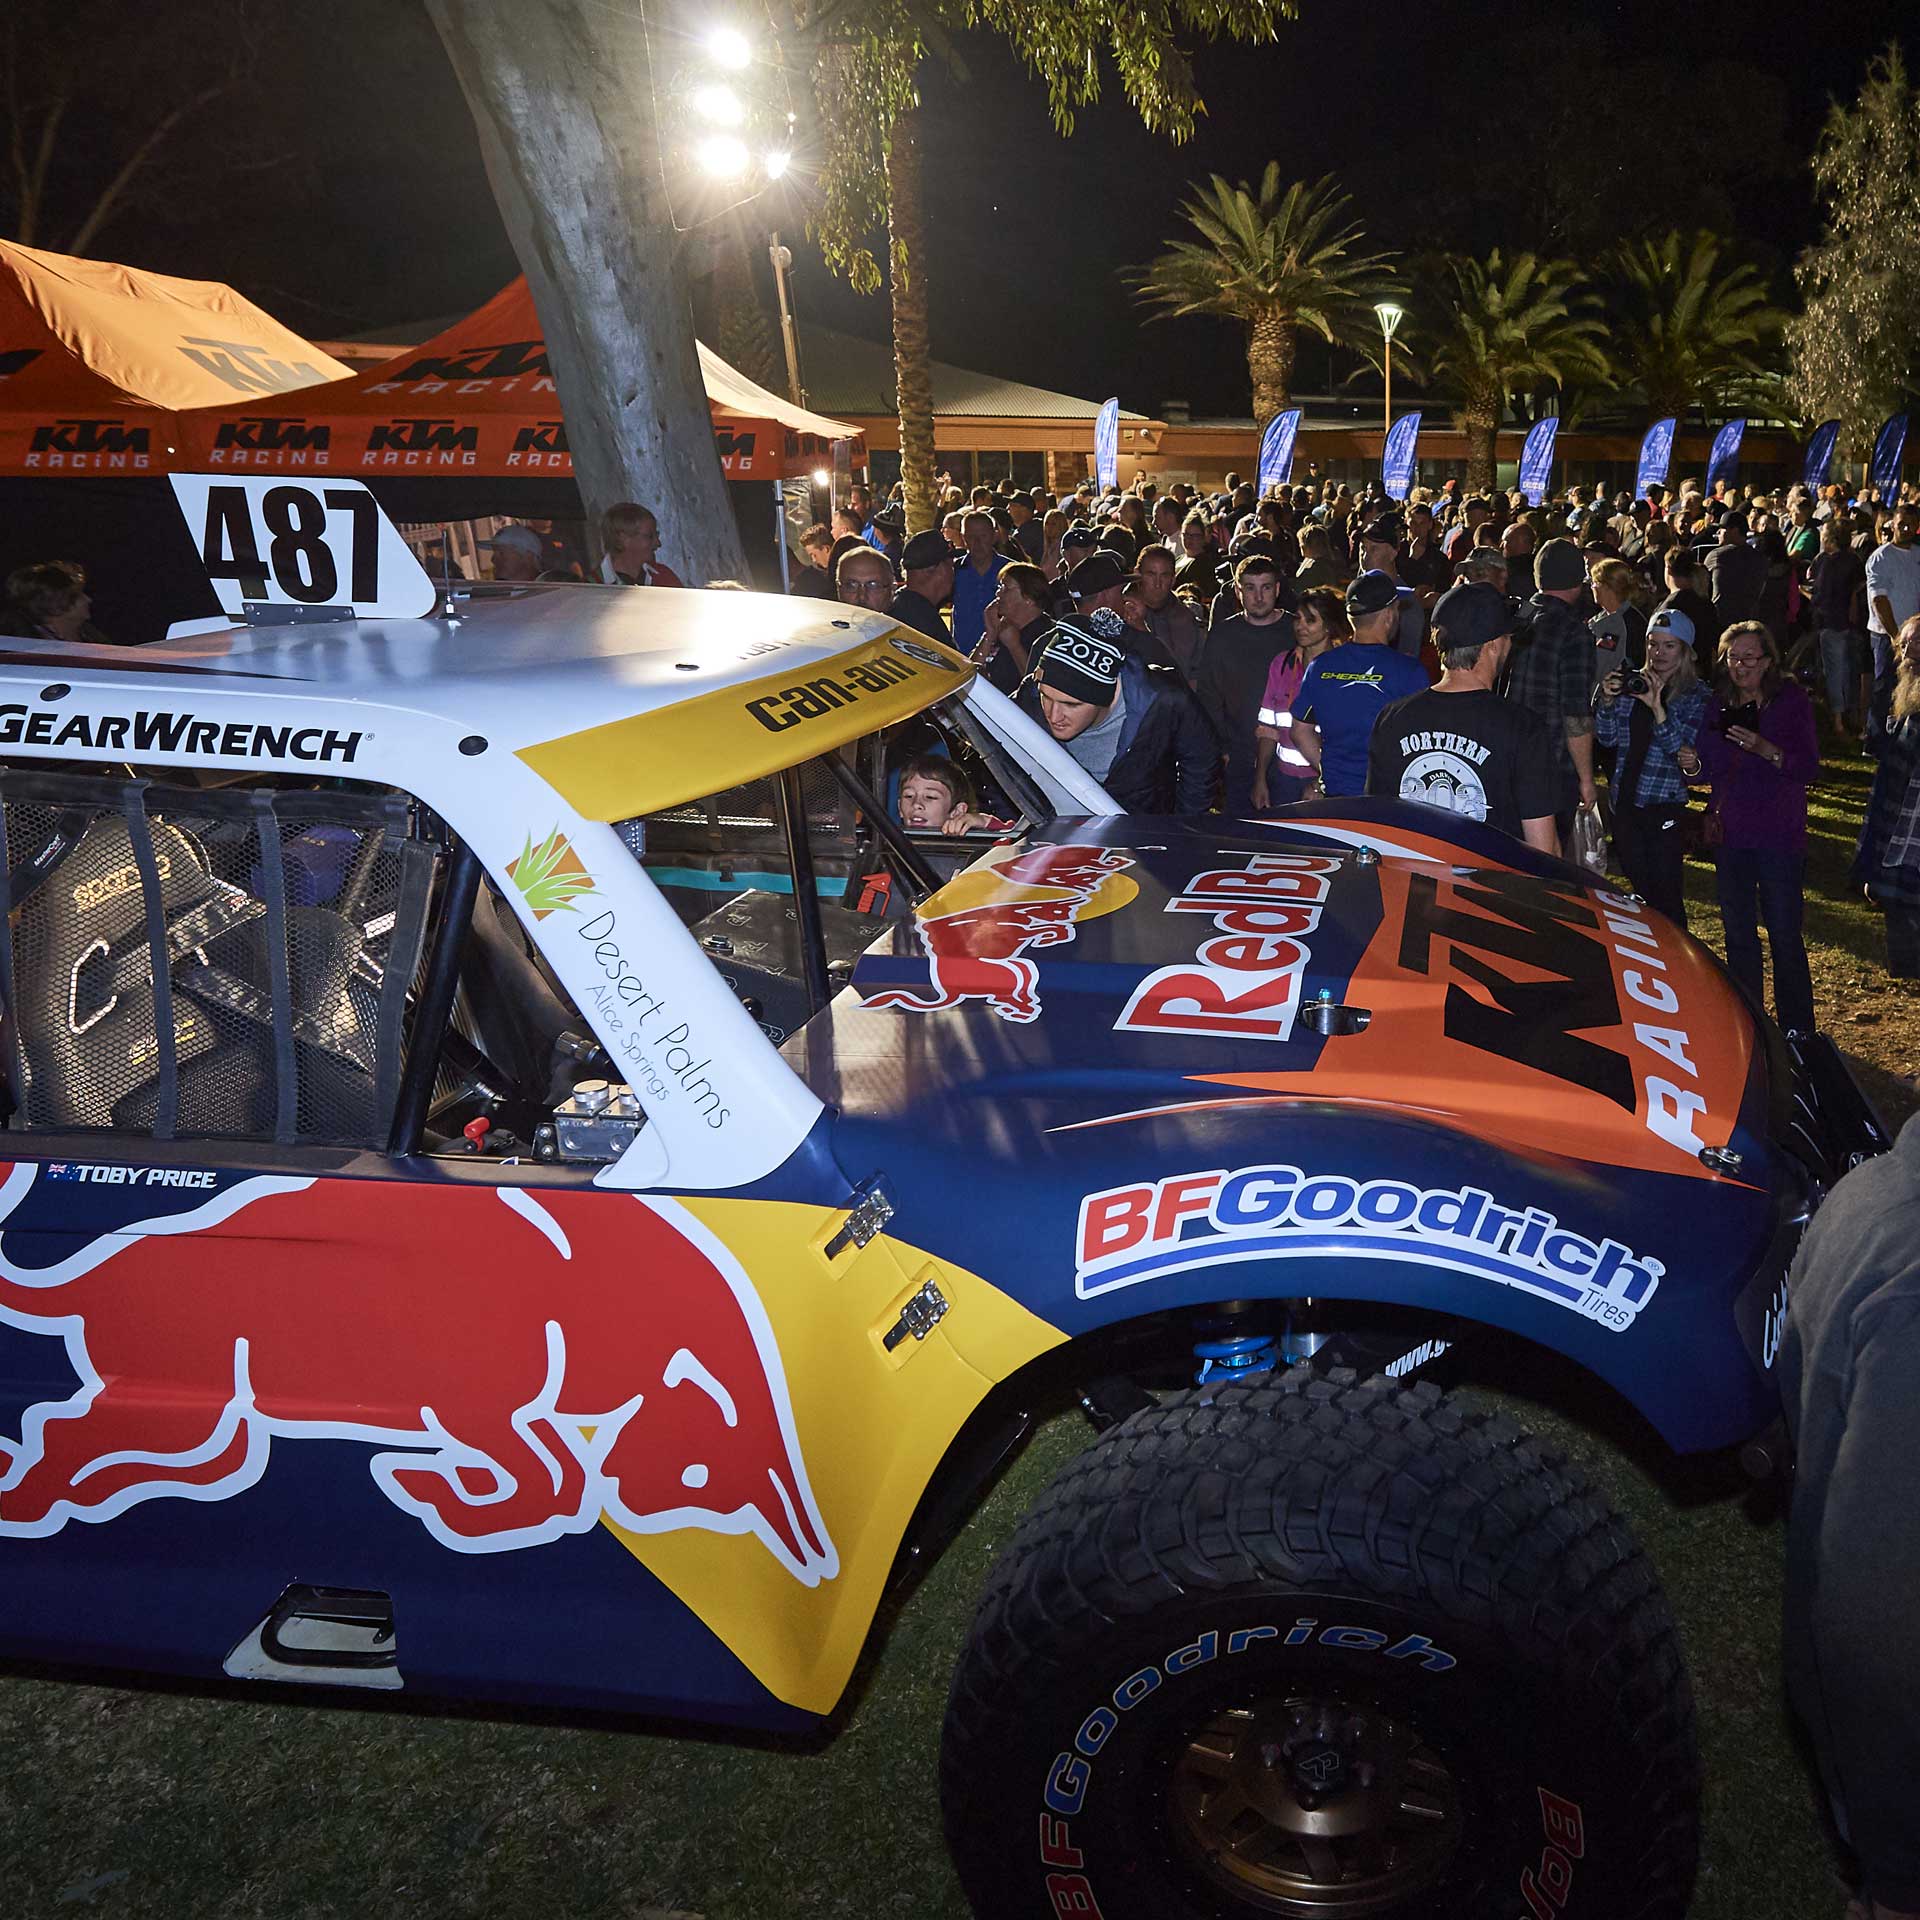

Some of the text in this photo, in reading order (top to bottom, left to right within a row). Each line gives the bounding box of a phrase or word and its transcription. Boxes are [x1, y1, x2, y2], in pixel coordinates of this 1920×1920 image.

[176, 335, 332, 393] KTM
[29, 419, 150, 452] KTM
[214, 417, 330, 449] KTM
[366, 419, 479, 451] KTM
[203, 485, 379, 604] 487
[1055, 635, 1114, 674] 2018
[1320, 672, 1384, 681] SHERCO
[1399, 731, 1492, 766] NORTHERN
[1397, 864, 1637, 1116] KTM
[578, 910, 665, 1027] Desert
[654, 1022, 731, 1129] Palms
[585, 984, 671, 1101] Alice Springs
[1593, 888, 1708, 1158] RACING
[77, 1164, 218, 1189] TOBY PRICE
[1082, 1169, 1653, 1304] BFGoodrich
[1581, 1286, 1631, 1327] Tires
[1039, 1616, 1458, 1920] BFGoodrich
